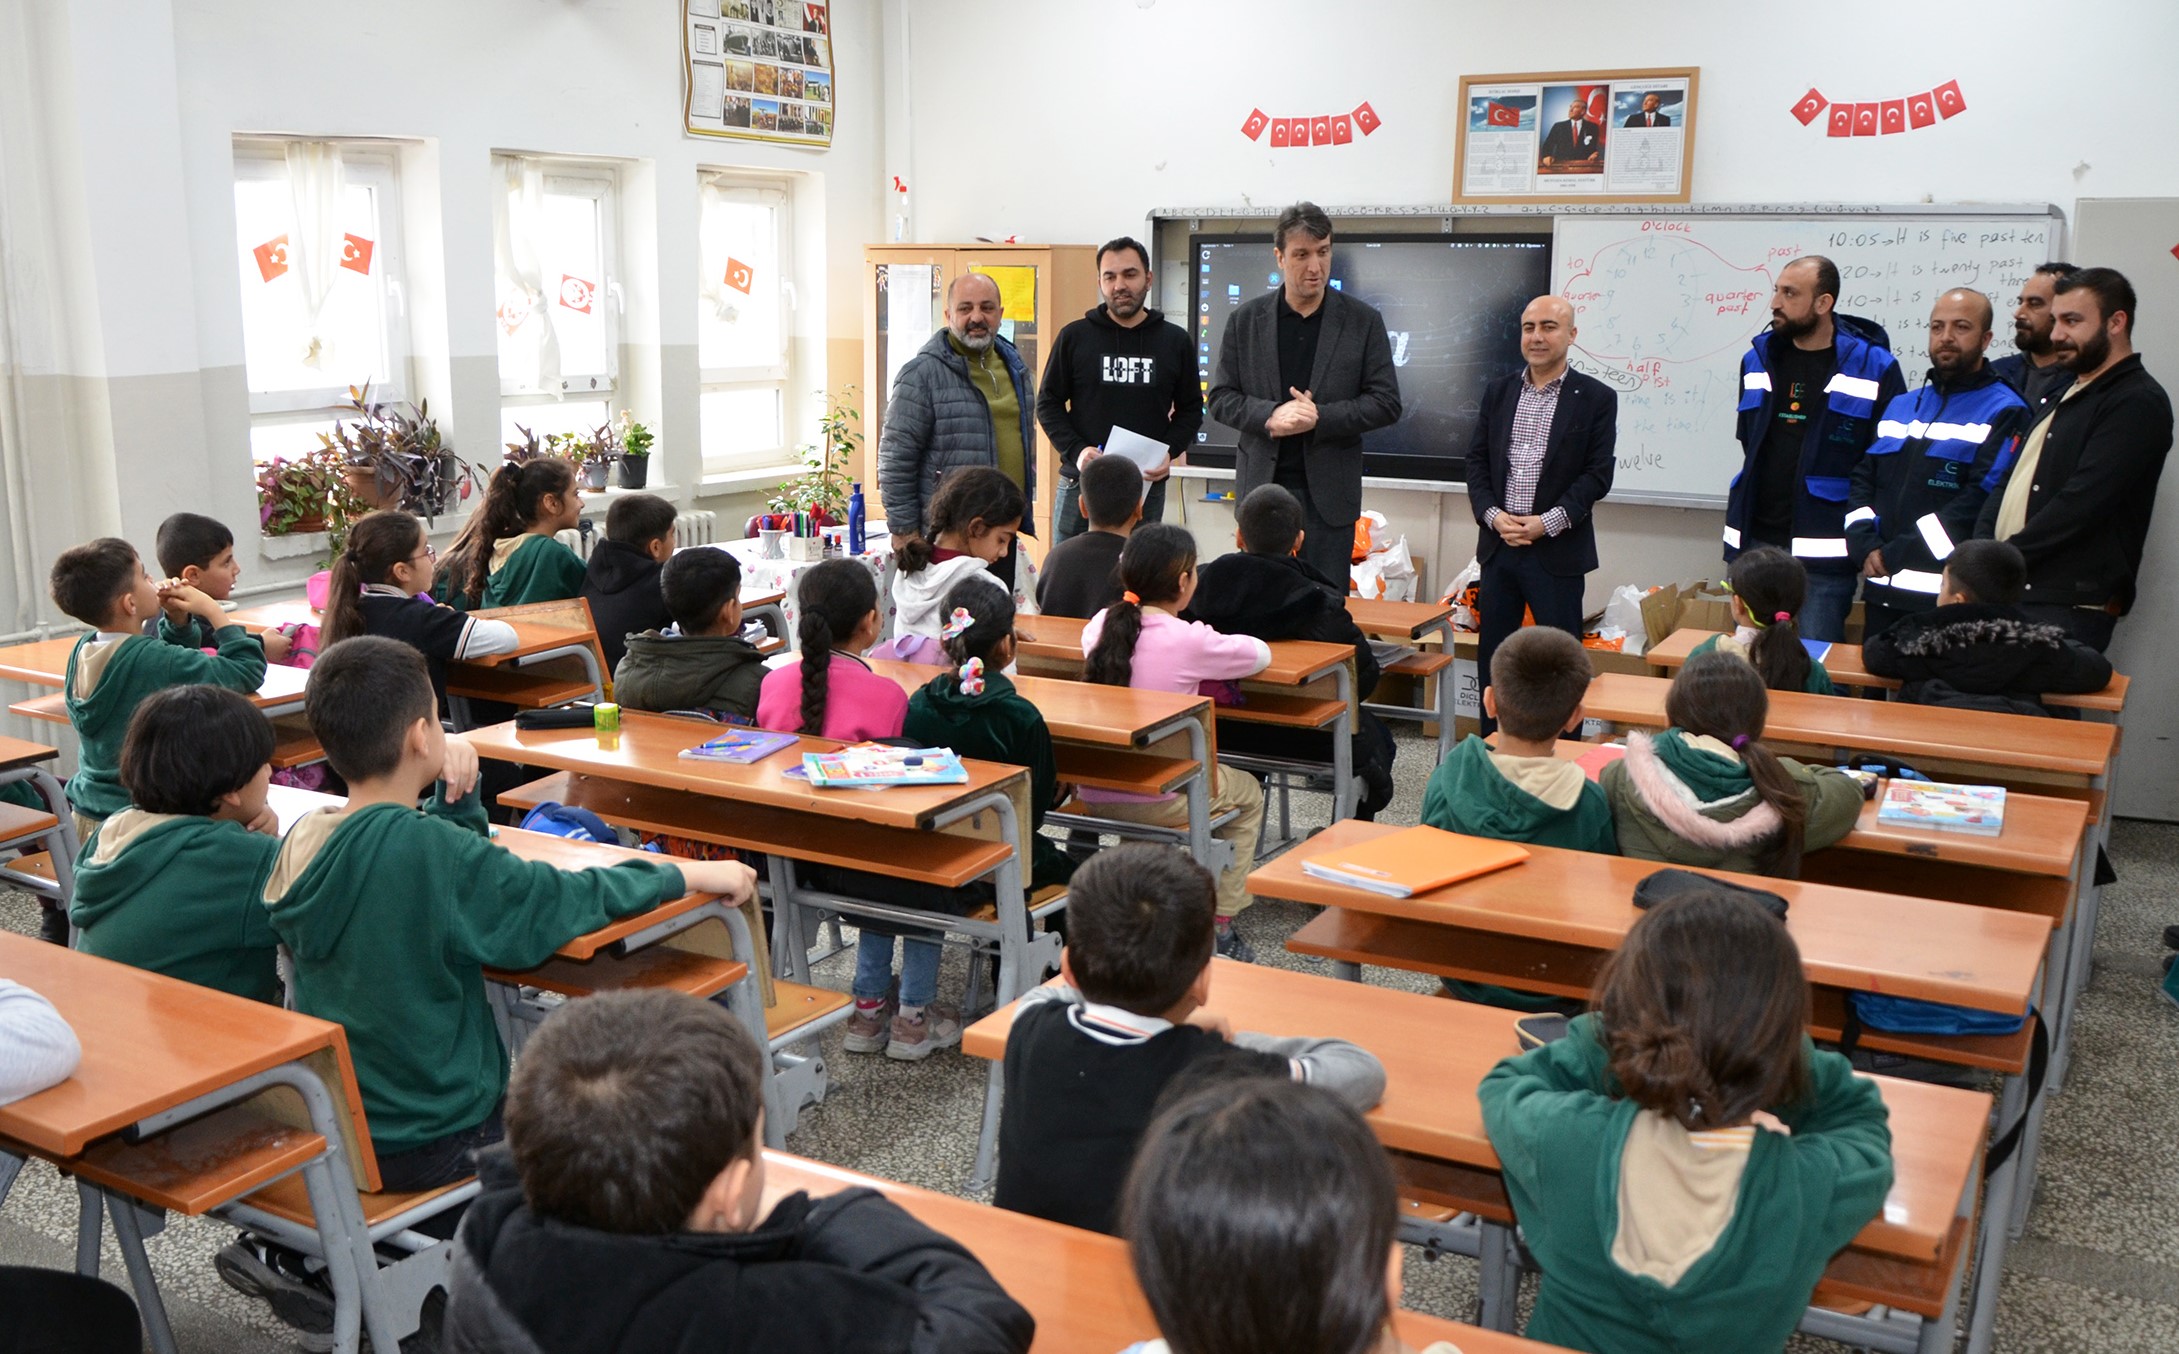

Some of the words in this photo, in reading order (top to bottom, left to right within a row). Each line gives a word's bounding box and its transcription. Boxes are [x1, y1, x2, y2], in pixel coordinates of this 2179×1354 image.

[1828, 231, 1880, 248] 10:05
[1919, 228, 1930, 243] is
[1941, 228, 1968, 250] five
[1980, 229, 2017, 249] past
[2020, 228, 2045, 245] ten
[1768, 244, 1802, 262] past
[1567, 256, 1584, 269] to
[1839, 265, 1869, 279] :20
[1912, 264, 1924, 276] is
[1931, 257, 1980, 285] twenty
[1989, 256, 2024, 278] past
[1678, 273, 1686, 286] 2
[1705, 289, 1763, 304] quarter
[1839, 295, 1867, 307] :10
[1911, 291, 1921, 303] is
[1717, 301, 1749, 316] past
[1898, 319, 1909, 329] is
[1103, 356, 1153, 383] LOFT
[1626, 360, 1662, 376] half
[1602, 365, 1636, 388] teen
[1664, 392, 1676, 405] is
[1618, 443, 1666, 471] welve
[1460, 692, 1480, 701] DİCL
